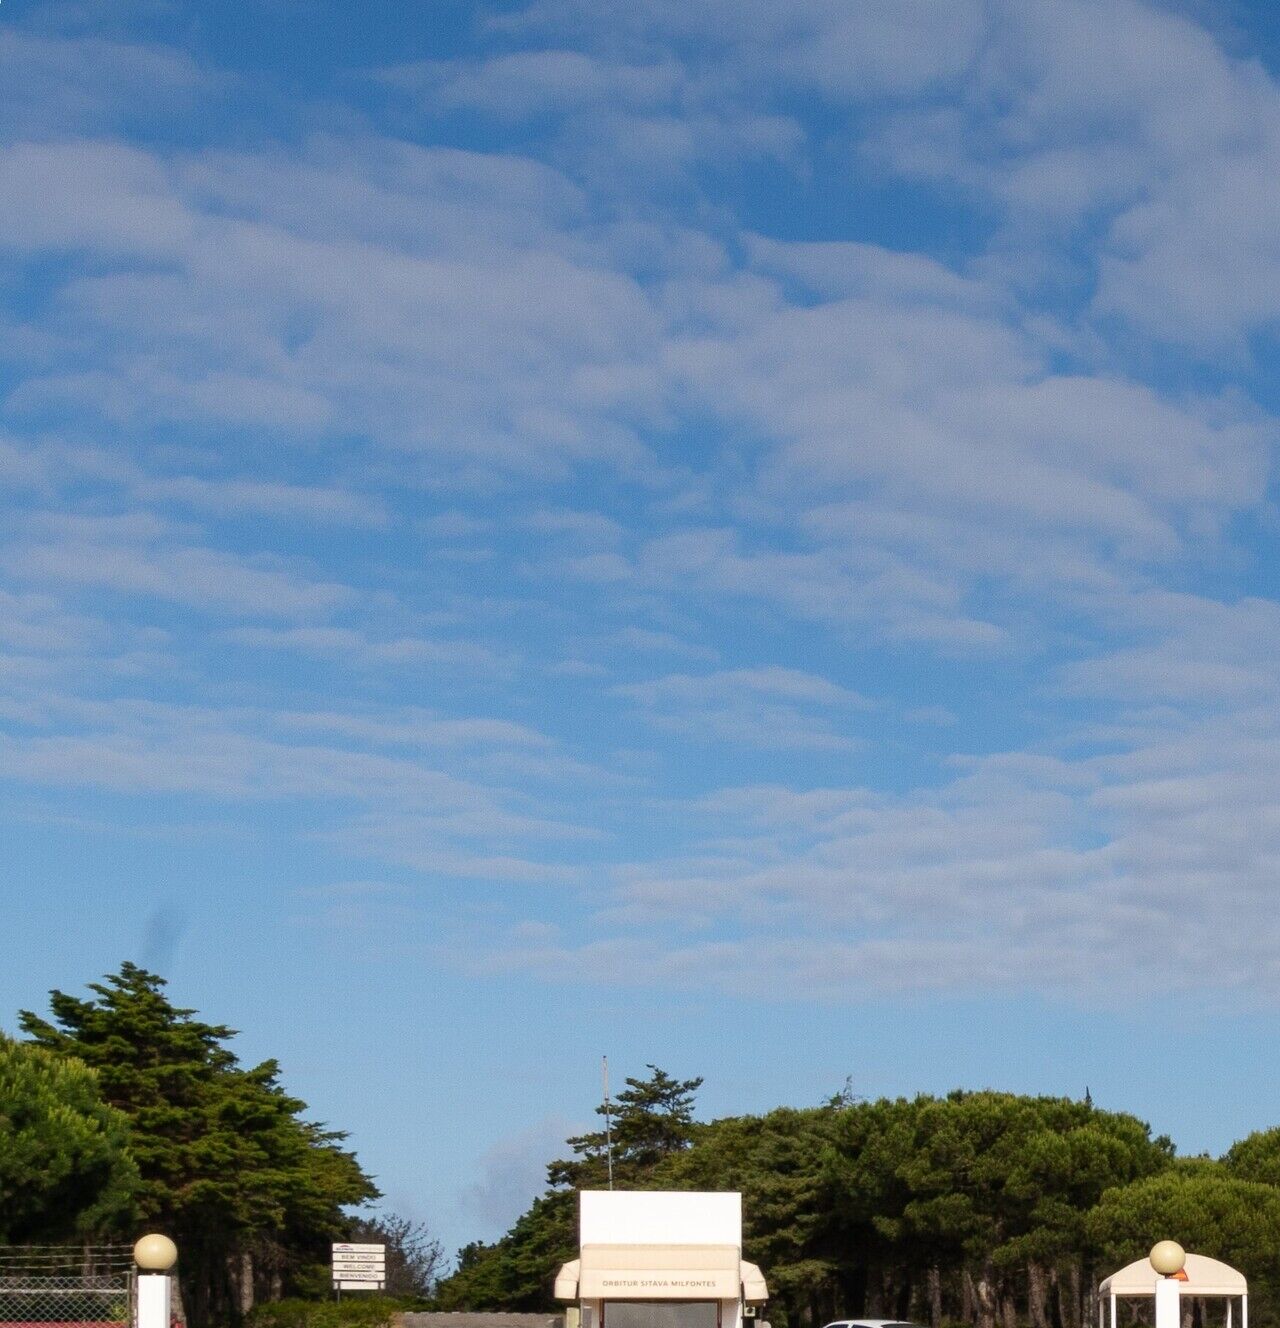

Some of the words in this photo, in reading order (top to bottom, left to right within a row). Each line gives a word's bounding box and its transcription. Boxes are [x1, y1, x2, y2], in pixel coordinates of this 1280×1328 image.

[602, 1279, 638, 1287] ORBITUR
[641, 1279, 669, 1287] SITAVA
[671, 1279, 716, 1287] MILFONTES
